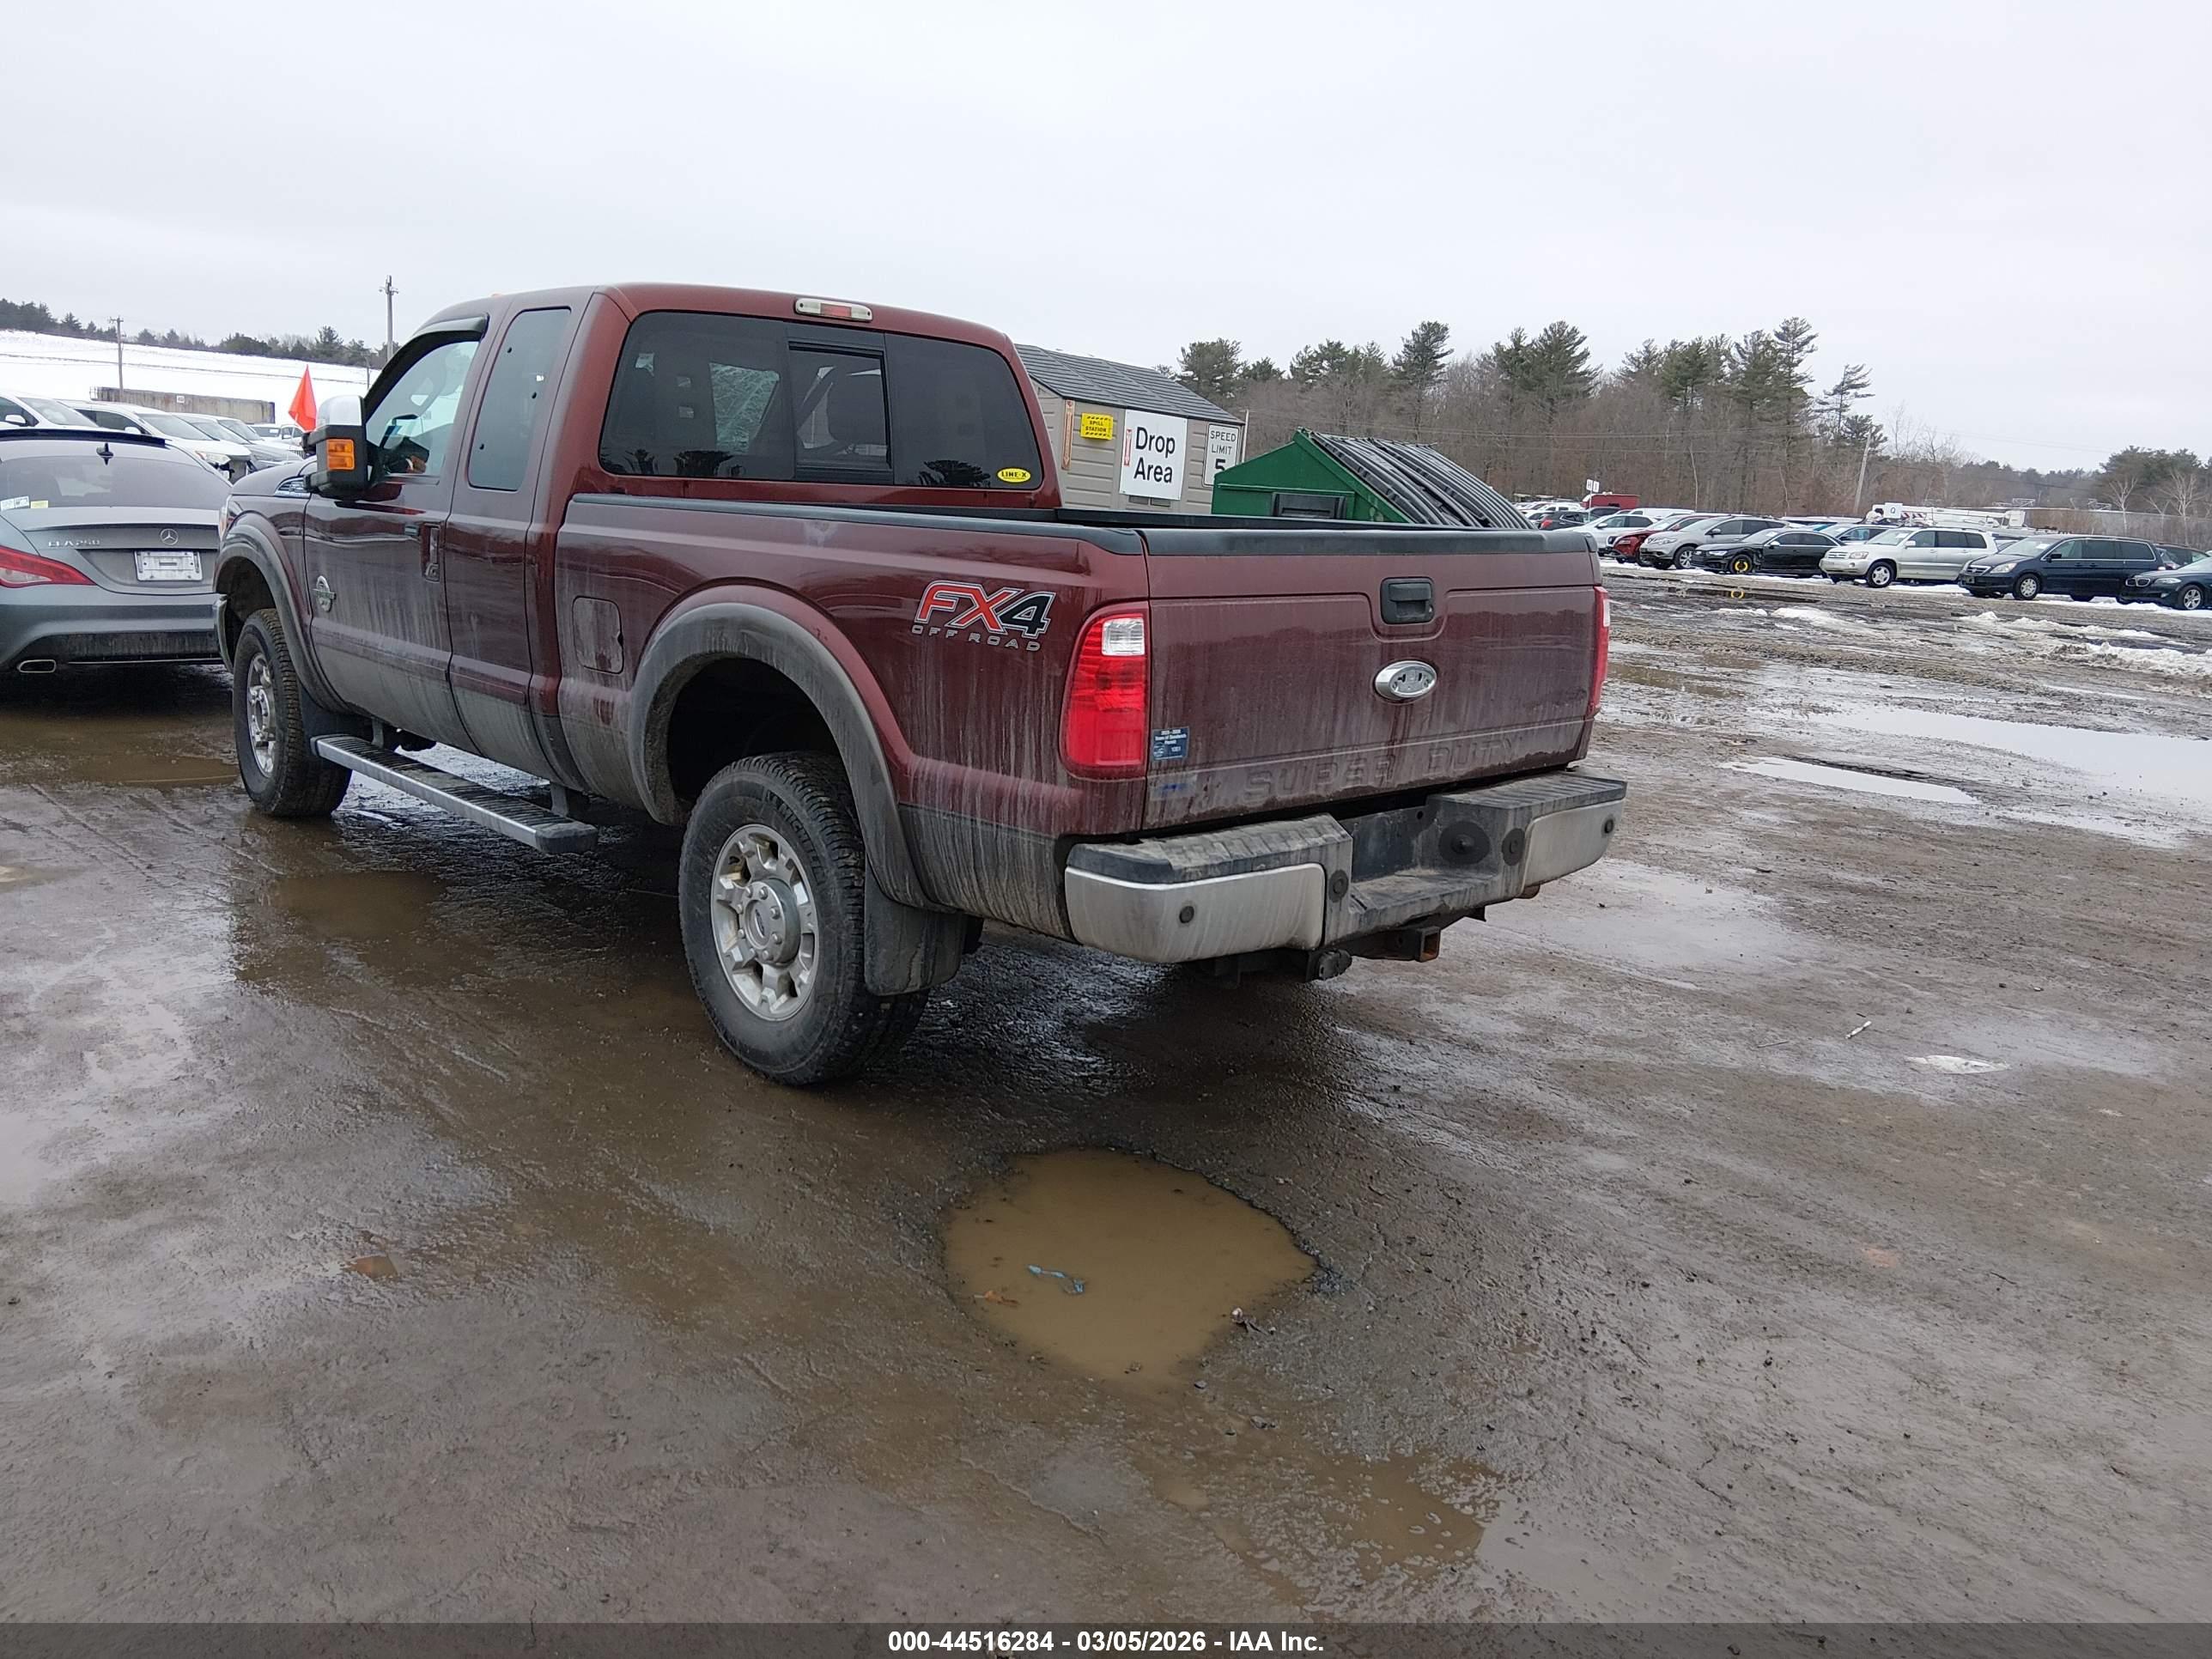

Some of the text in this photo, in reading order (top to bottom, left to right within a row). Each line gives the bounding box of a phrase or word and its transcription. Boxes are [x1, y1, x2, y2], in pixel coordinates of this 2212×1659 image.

[1135, 426, 1176, 459] Drop
[1210, 430, 1237, 442] SPEED
[1211, 444, 1232, 455] LIMIT
[1133, 457, 1173, 483] Area
[1215, 458, 1226, 471] 5
[914, 580, 1057, 640] FX4
[911, 624, 1041, 652] OFF ROAD
